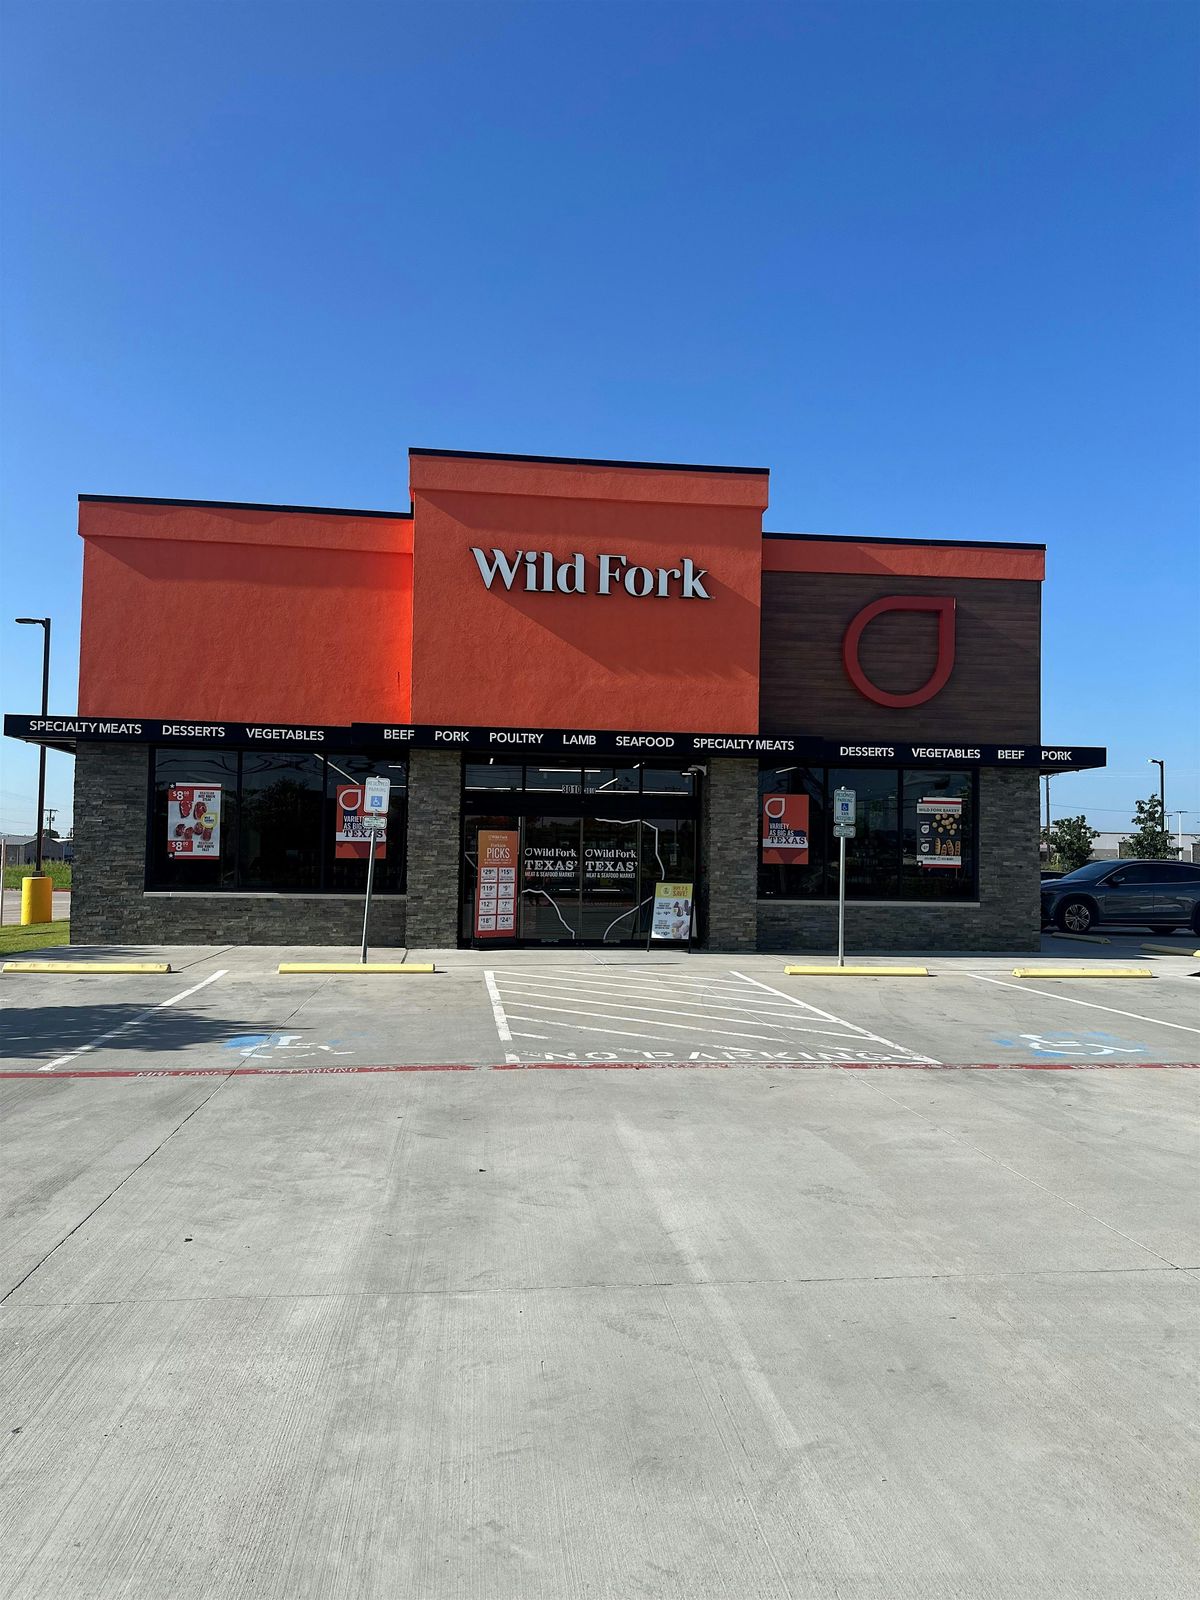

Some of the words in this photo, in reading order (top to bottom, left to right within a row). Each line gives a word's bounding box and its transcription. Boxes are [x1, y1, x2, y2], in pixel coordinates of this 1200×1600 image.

[470, 547, 586, 594] Wild
[597, 554, 711, 599] Fork
[29, 720, 97, 734] SPECIALTY
[98, 723, 142, 735] MEATS
[162, 724, 225, 738] DESSERTS
[245, 728, 325, 741] VEGETABLES
[383, 729, 415, 740] BEEF
[434, 730, 470, 742] PORK
[489, 732, 544, 744] POULTRY
[562, 734, 597, 745] LAMB
[615, 735, 675, 748] SEAFOOD
[693, 738, 754, 750] SPECIALTY
[755, 740, 795, 751] MEATS
[839, 746, 895, 757] DESSERTS
[911, 747, 981, 759] VEGETABLES
[997, 749, 1025, 760] BEEF
[1041, 750, 1073, 761] PORK
[343, 815, 363, 823] VARIET
[768, 836, 806, 845] TEXAS
[486, 847, 510, 859] PICKS
[534, 848, 554, 857] Wild
[555, 848, 577, 857] Fork
[594, 849, 614, 858] Wild
[615, 849, 637, 858] Fork
[544, 1051, 617, 1060] NO
[640, 1051, 886, 1061] PARKING
